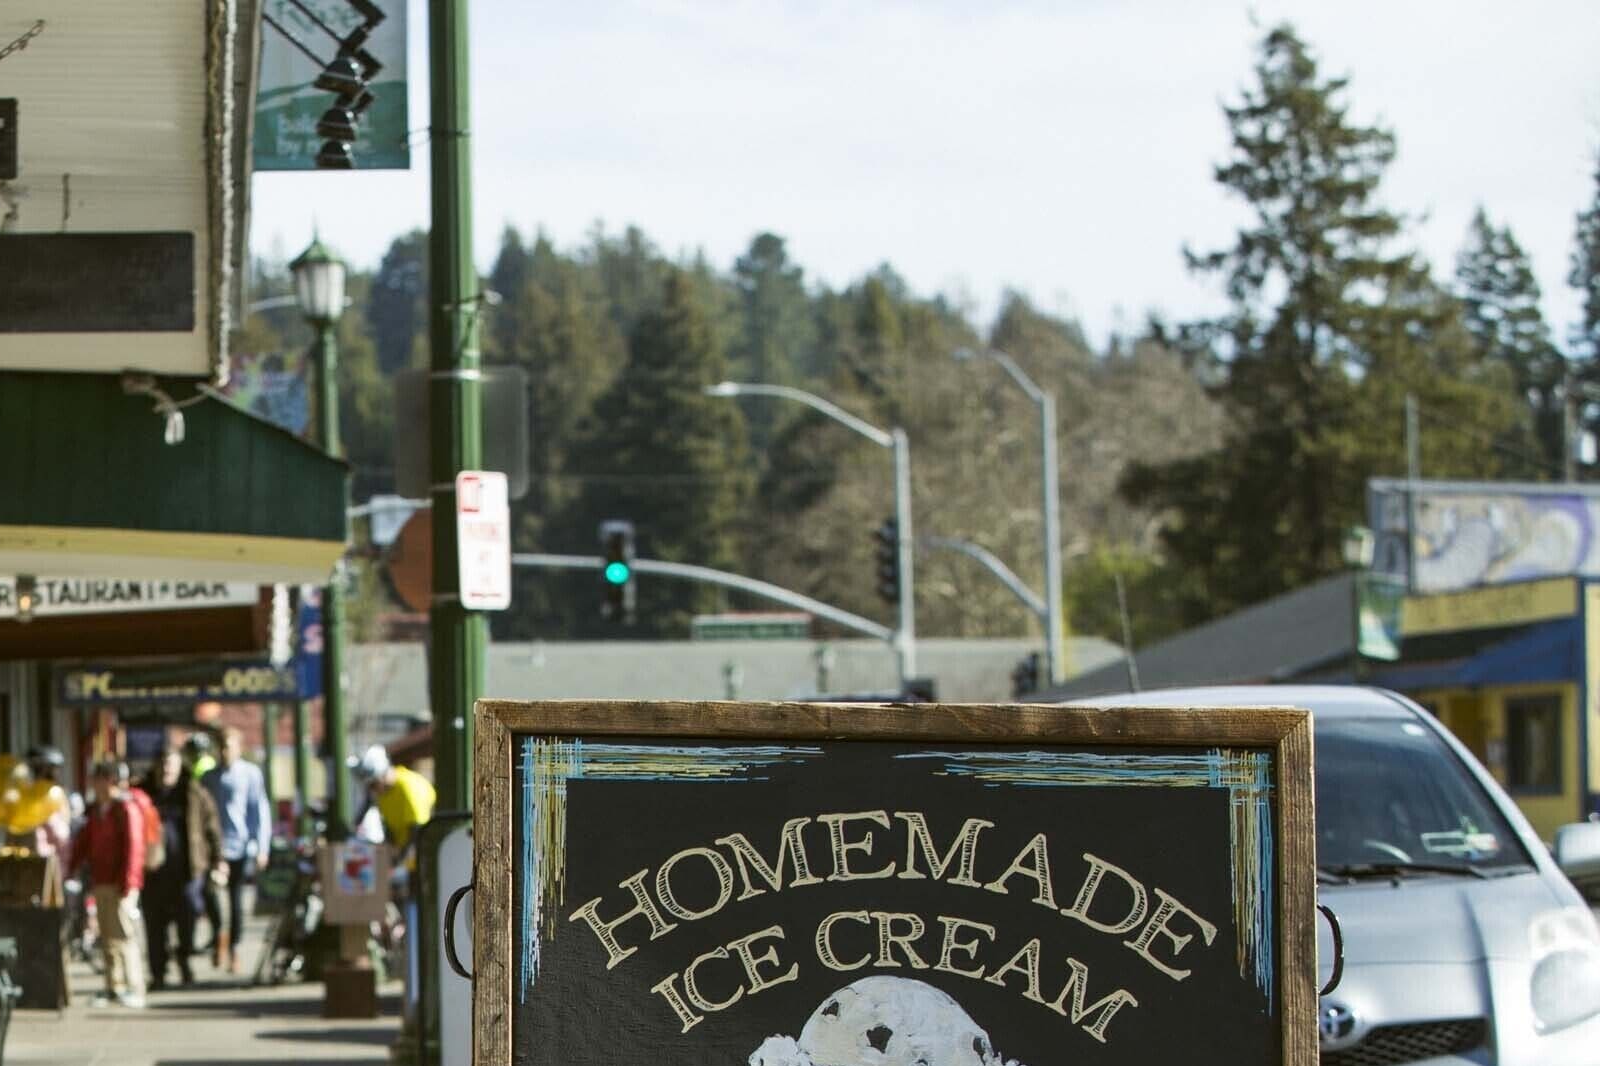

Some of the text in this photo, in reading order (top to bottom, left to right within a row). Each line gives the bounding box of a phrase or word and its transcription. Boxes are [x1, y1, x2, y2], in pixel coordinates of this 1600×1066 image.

[568, 809, 1218, 982] HOMEMADE
[650, 910, 1139, 1044] ICE CREAM
